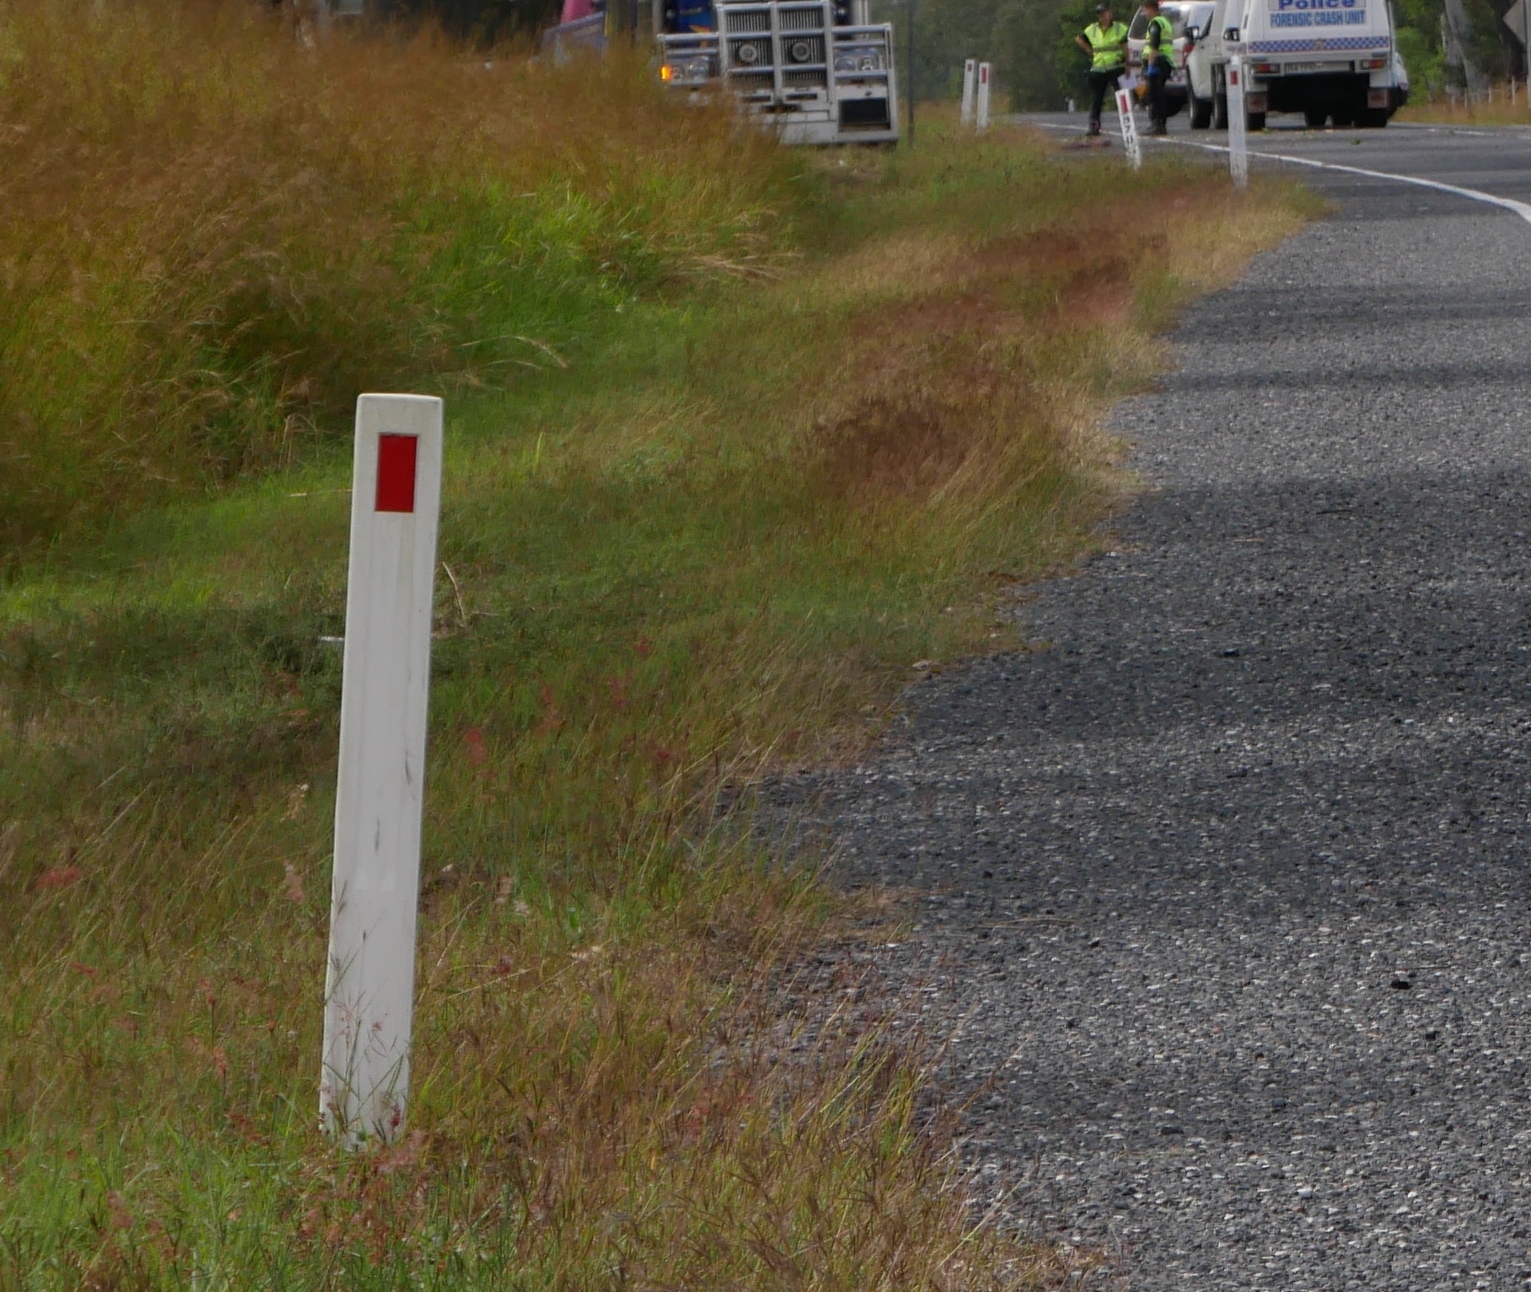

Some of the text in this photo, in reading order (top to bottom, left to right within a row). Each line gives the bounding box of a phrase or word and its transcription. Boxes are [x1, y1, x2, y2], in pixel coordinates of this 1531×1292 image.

[1270, 9, 1365, 28] FORENSIC CRASH UNIT
